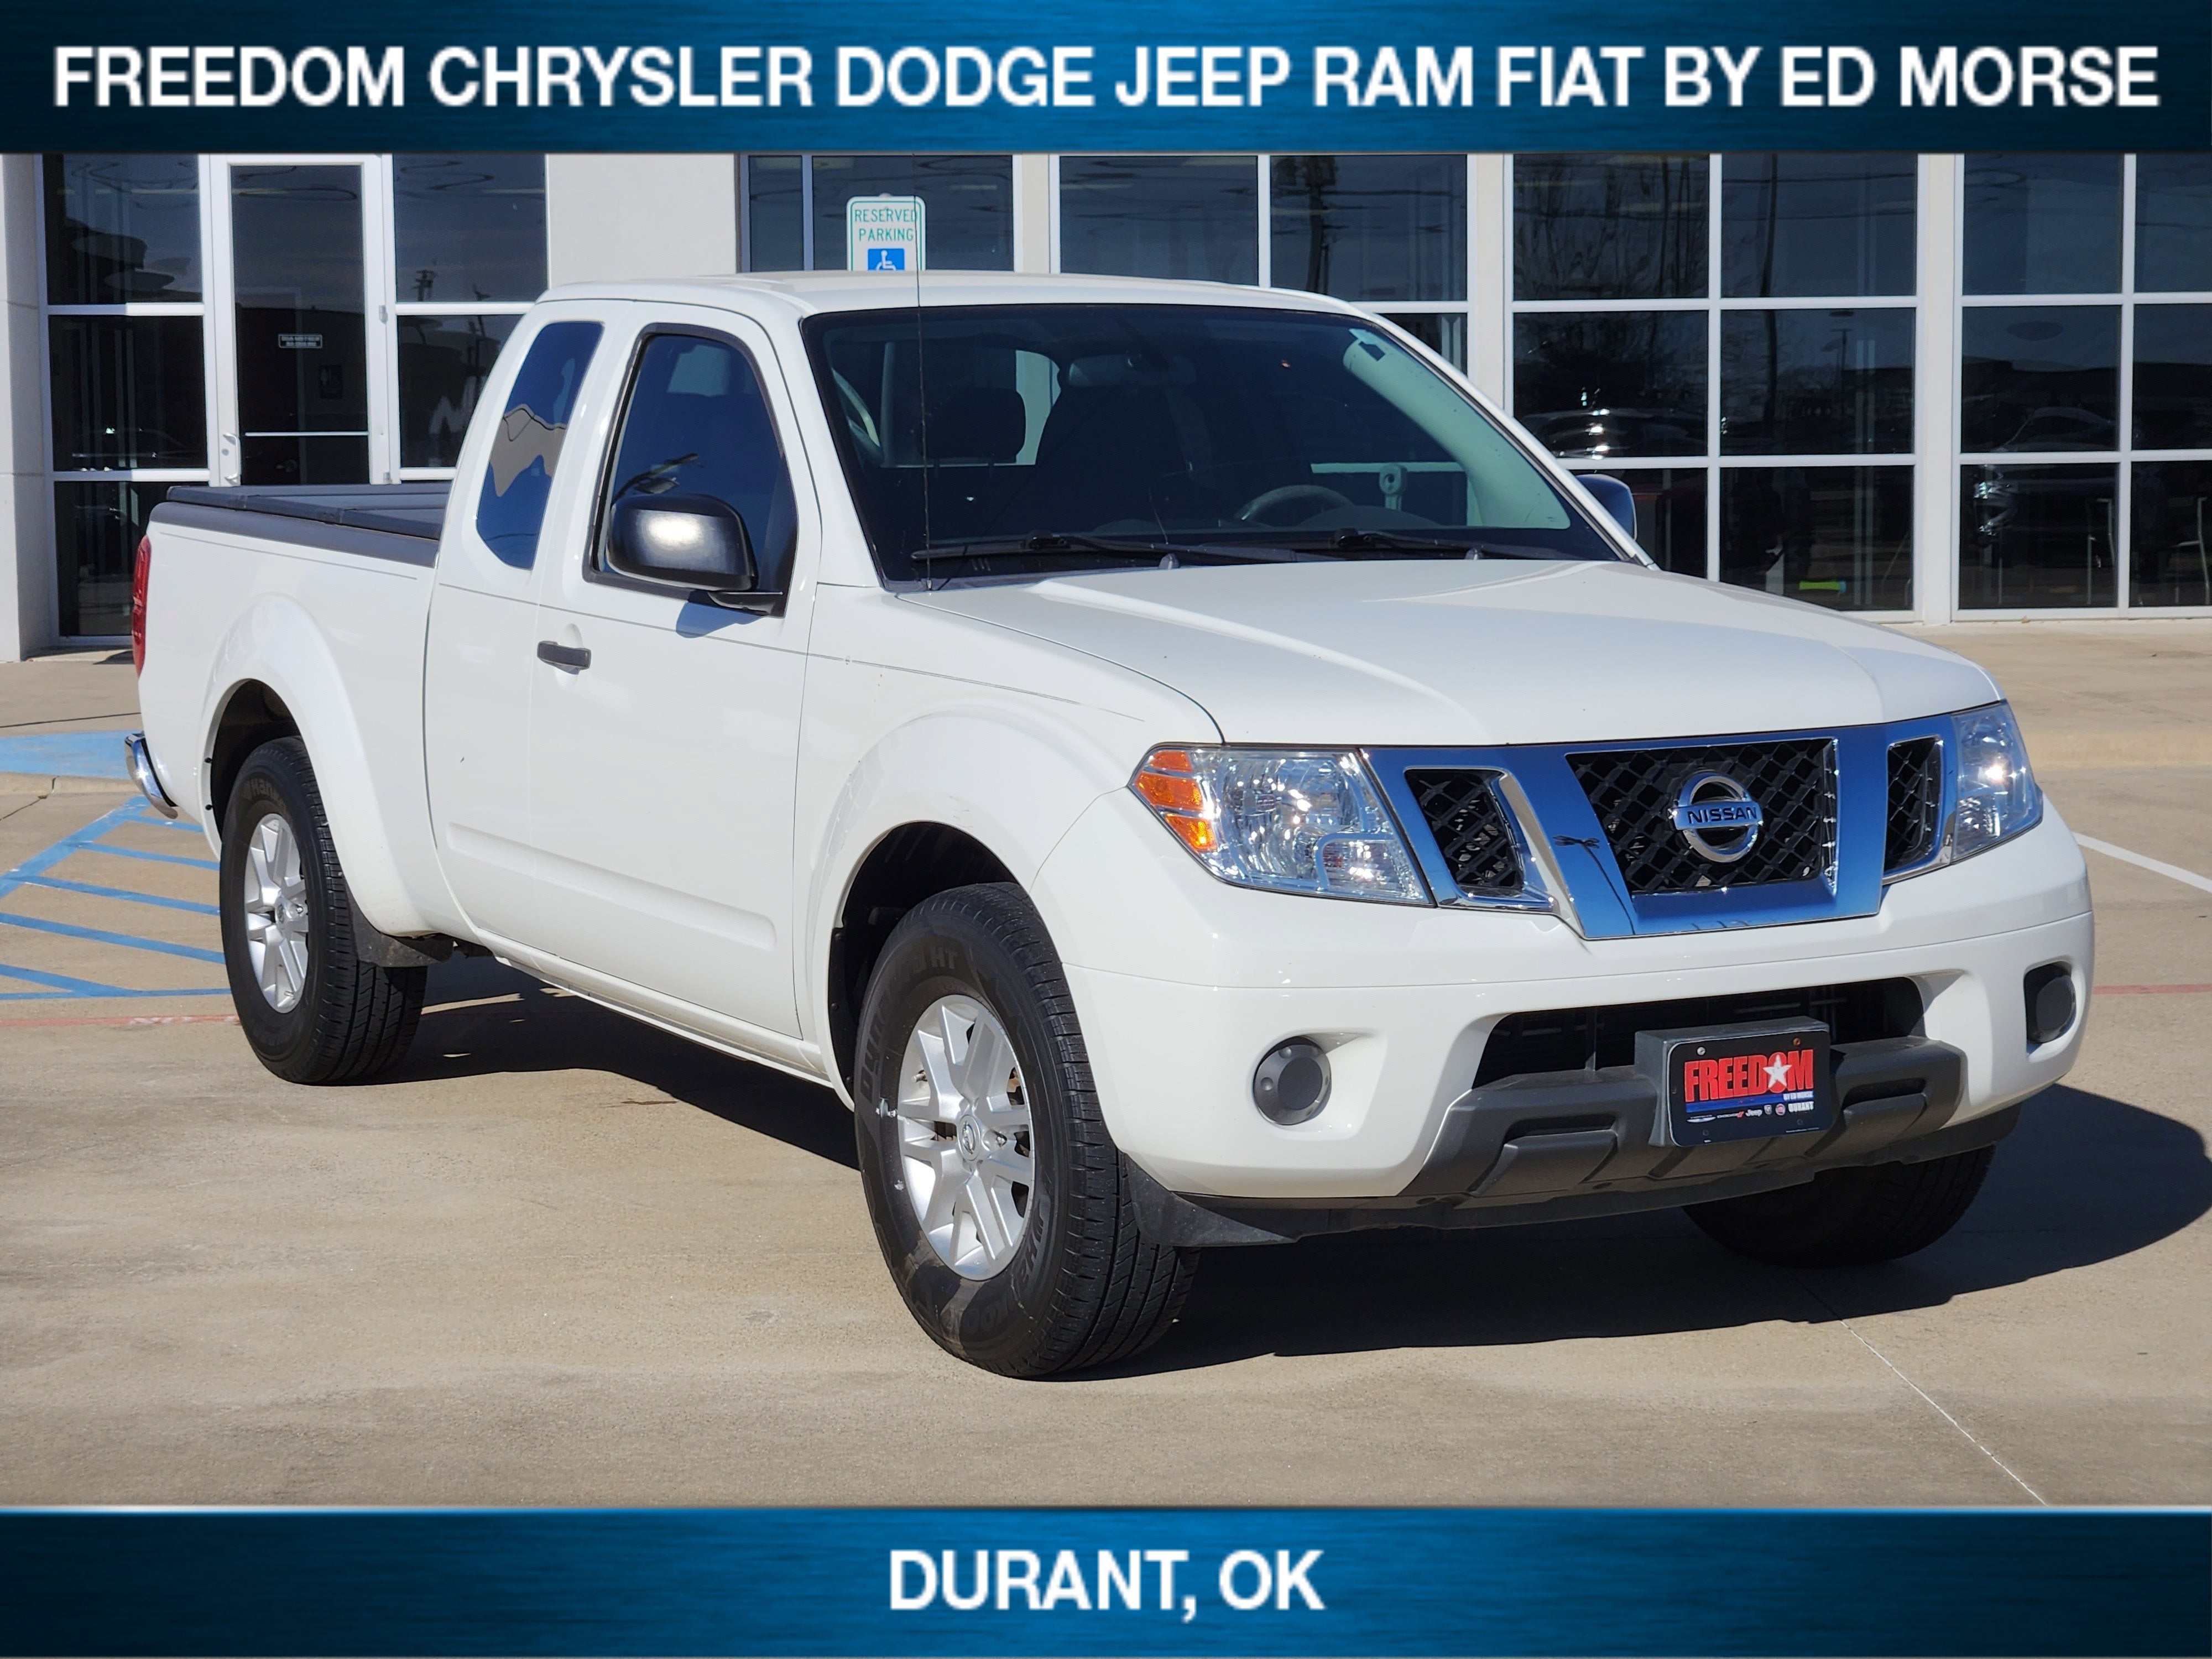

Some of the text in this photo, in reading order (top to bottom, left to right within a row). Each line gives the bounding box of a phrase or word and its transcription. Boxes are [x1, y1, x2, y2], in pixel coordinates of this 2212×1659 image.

[854, 209, 918, 222] RESERVED
[859, 228, 914, 241] PARKING
[1687, 807, 1757, 824] NISSAN
[1684, 1048, 1814, 1103] FREEDOM
[1745, 1109, 1763, 1117] Jeep
